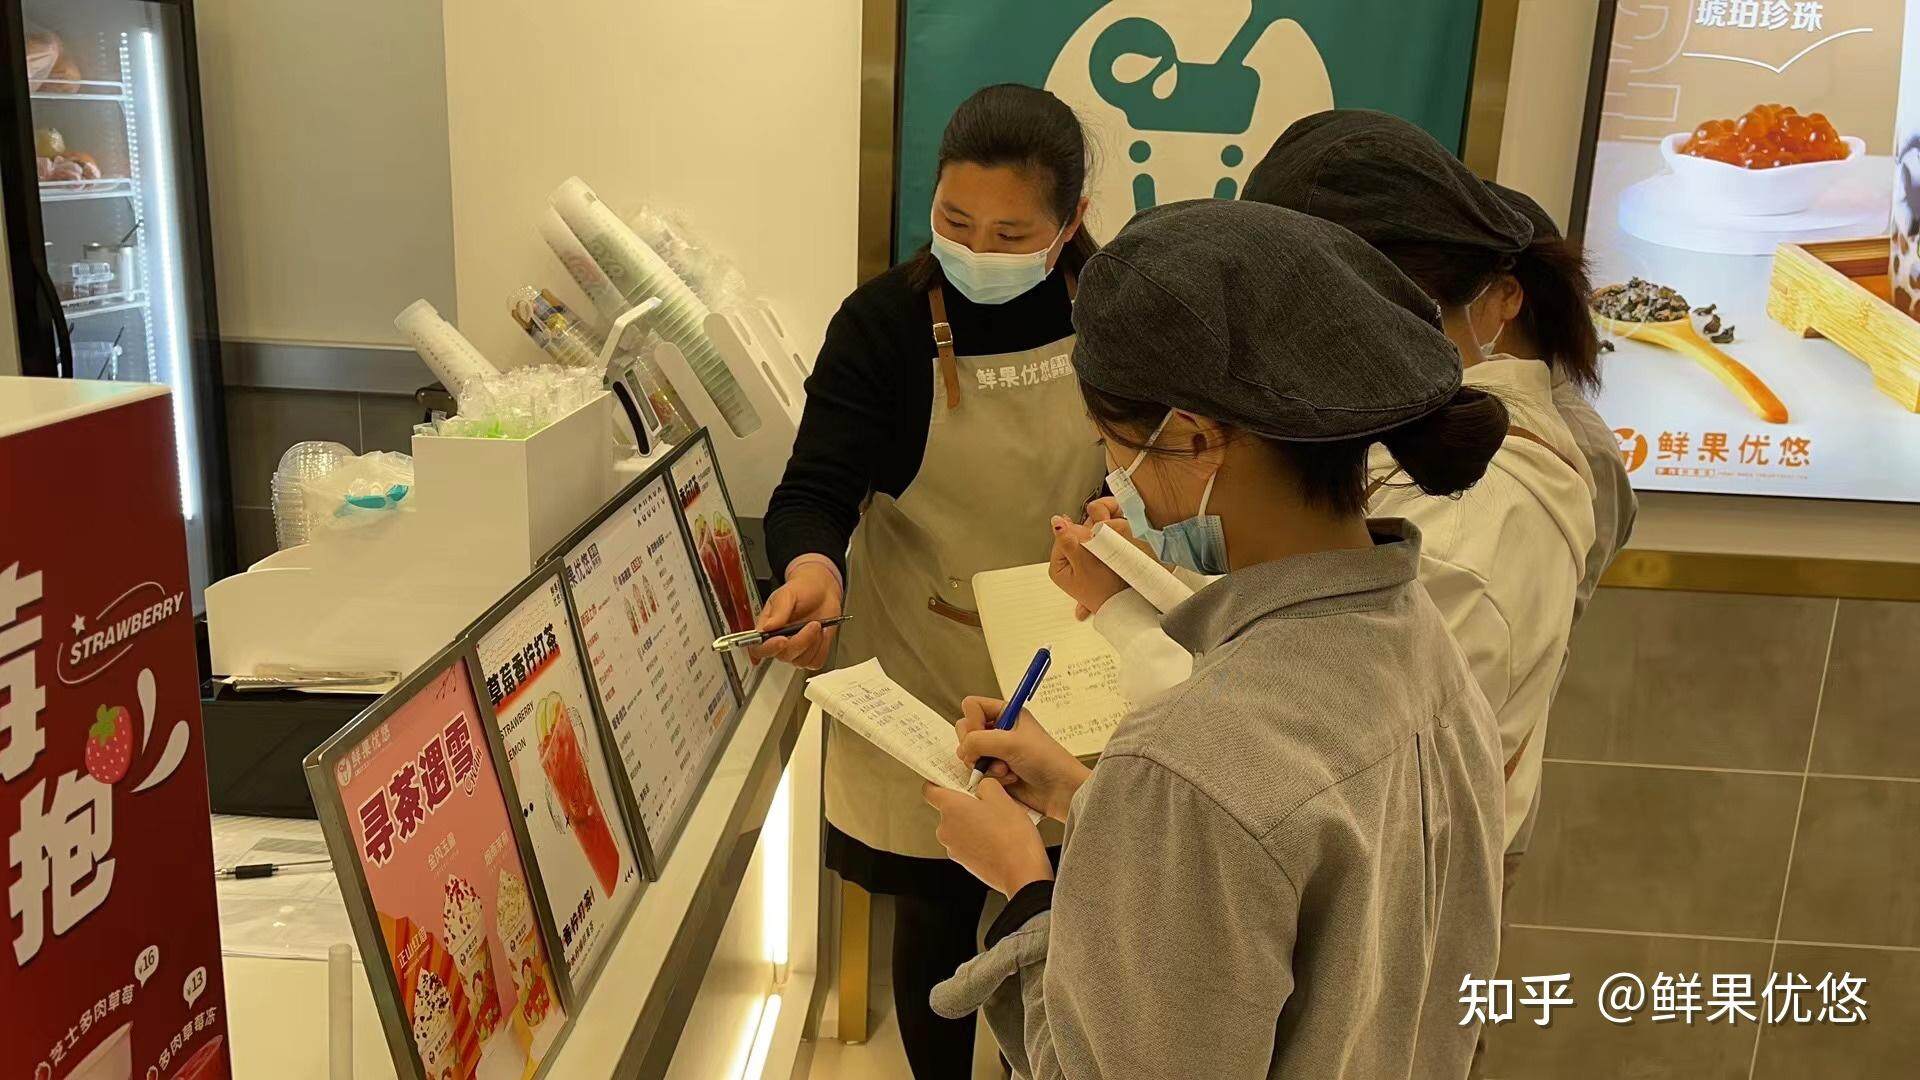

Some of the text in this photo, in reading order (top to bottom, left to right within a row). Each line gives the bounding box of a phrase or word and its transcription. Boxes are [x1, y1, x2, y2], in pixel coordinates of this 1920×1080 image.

[1696, 0, 1824, 32] 琥珀珍珠
[1656, 430, 1812, 468] 鲜果优悠
[70, 591, 184, 665] STRAWBERRY
[487, 623, 559, 705] 草莓香柠打茶
[500, 700, 534, 739] STRAWBERRY
[358, 711, 476, 868] 寻茶遇雪
[462, 746, 483, 797] Cream
[49, 984, 135, 1067] 芝士多肉草莓
[158, 1006, 218, 1072] 多肉草莓冻
